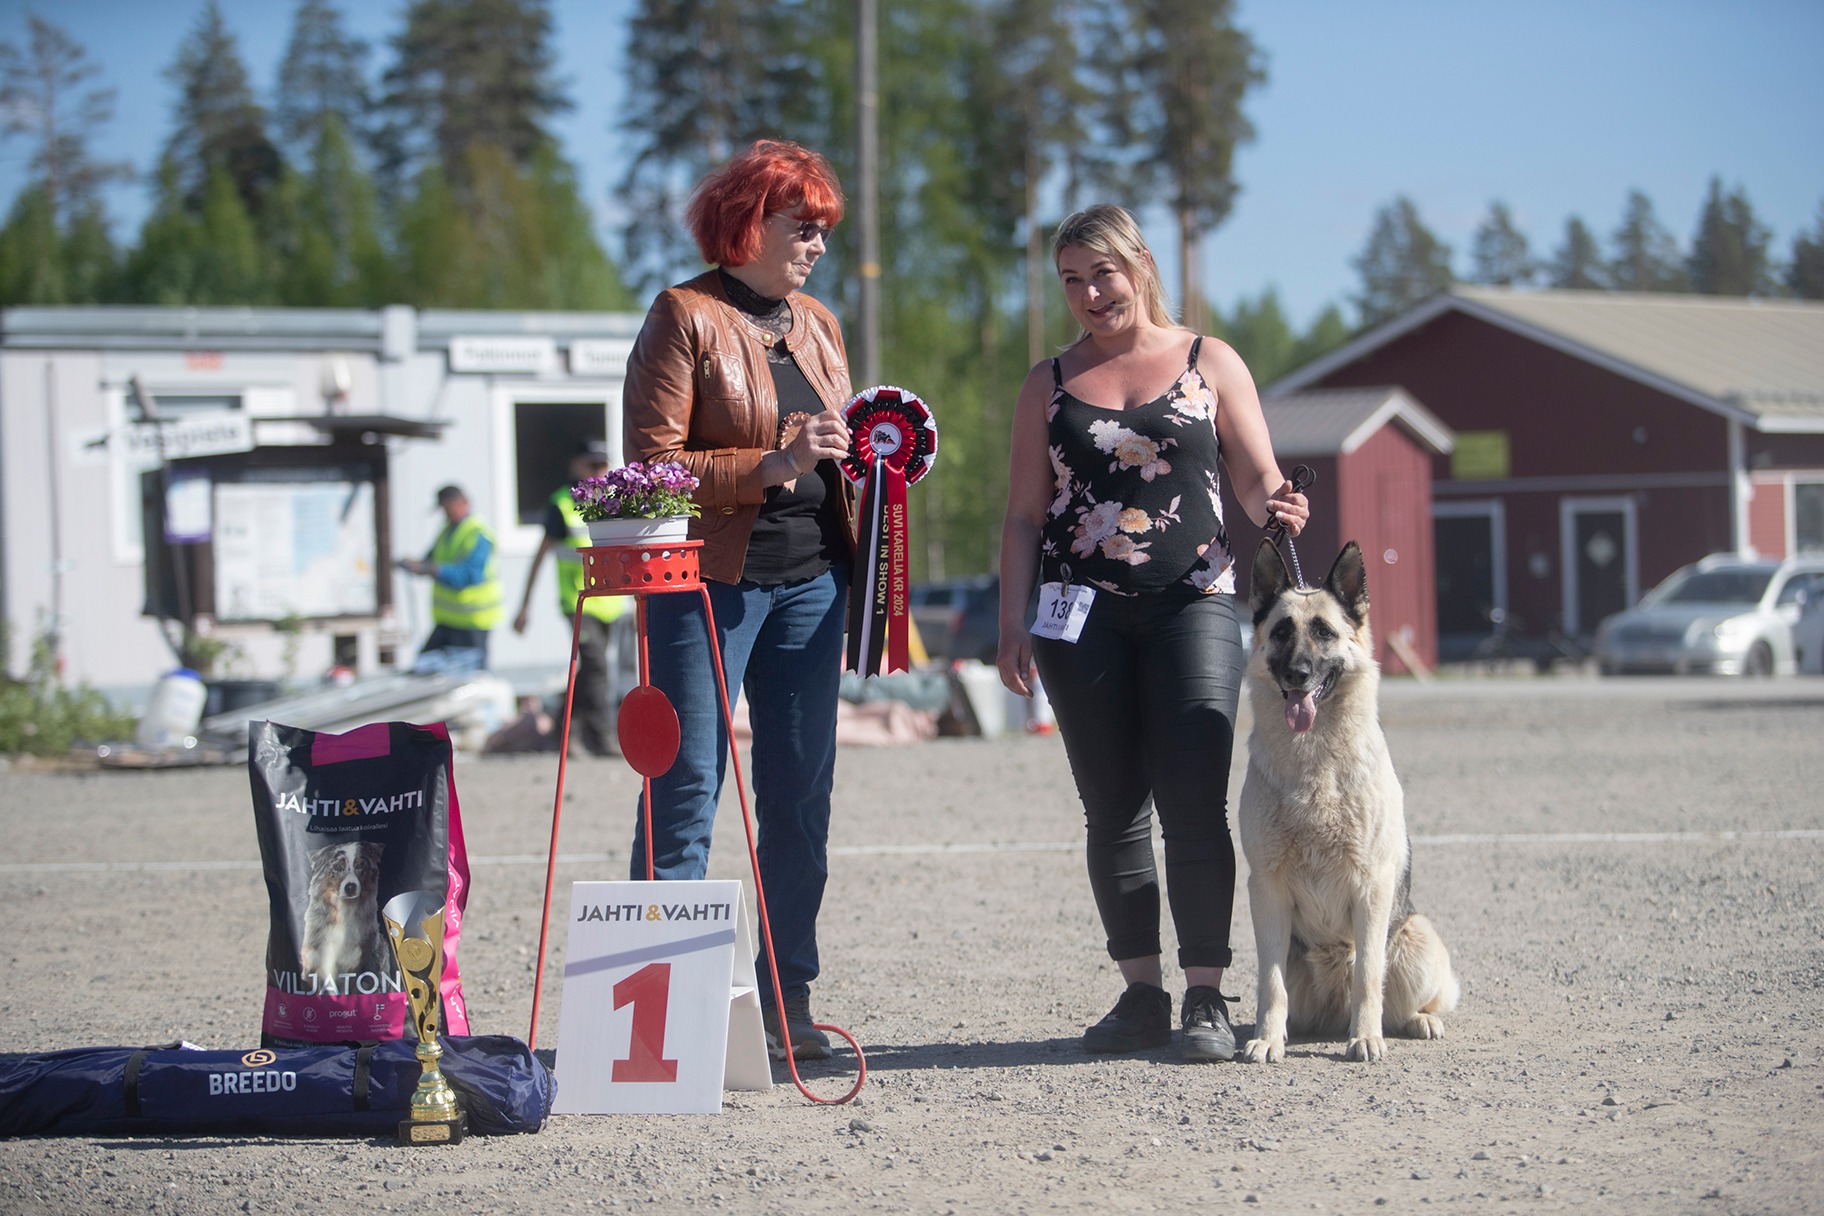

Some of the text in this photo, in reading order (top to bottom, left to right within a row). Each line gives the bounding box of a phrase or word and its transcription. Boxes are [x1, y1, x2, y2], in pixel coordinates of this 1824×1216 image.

[880, 545, 889, 558] IN
[893, 503, 904, 617] SUVI KARELIA KR 2024
[877, 562, 889, 604] SHOW
[275, 790, 423, 817] JAHTI&VAHTI
[577, 903, 731, 922] JAHTI&VAHTI
[273, 968, 402, 996] VILJATON
[329, 1009, 357, 1019] progut
[611, 962, 679, 1083] 1
[209, 1071, 297, 1096] BREEDO
